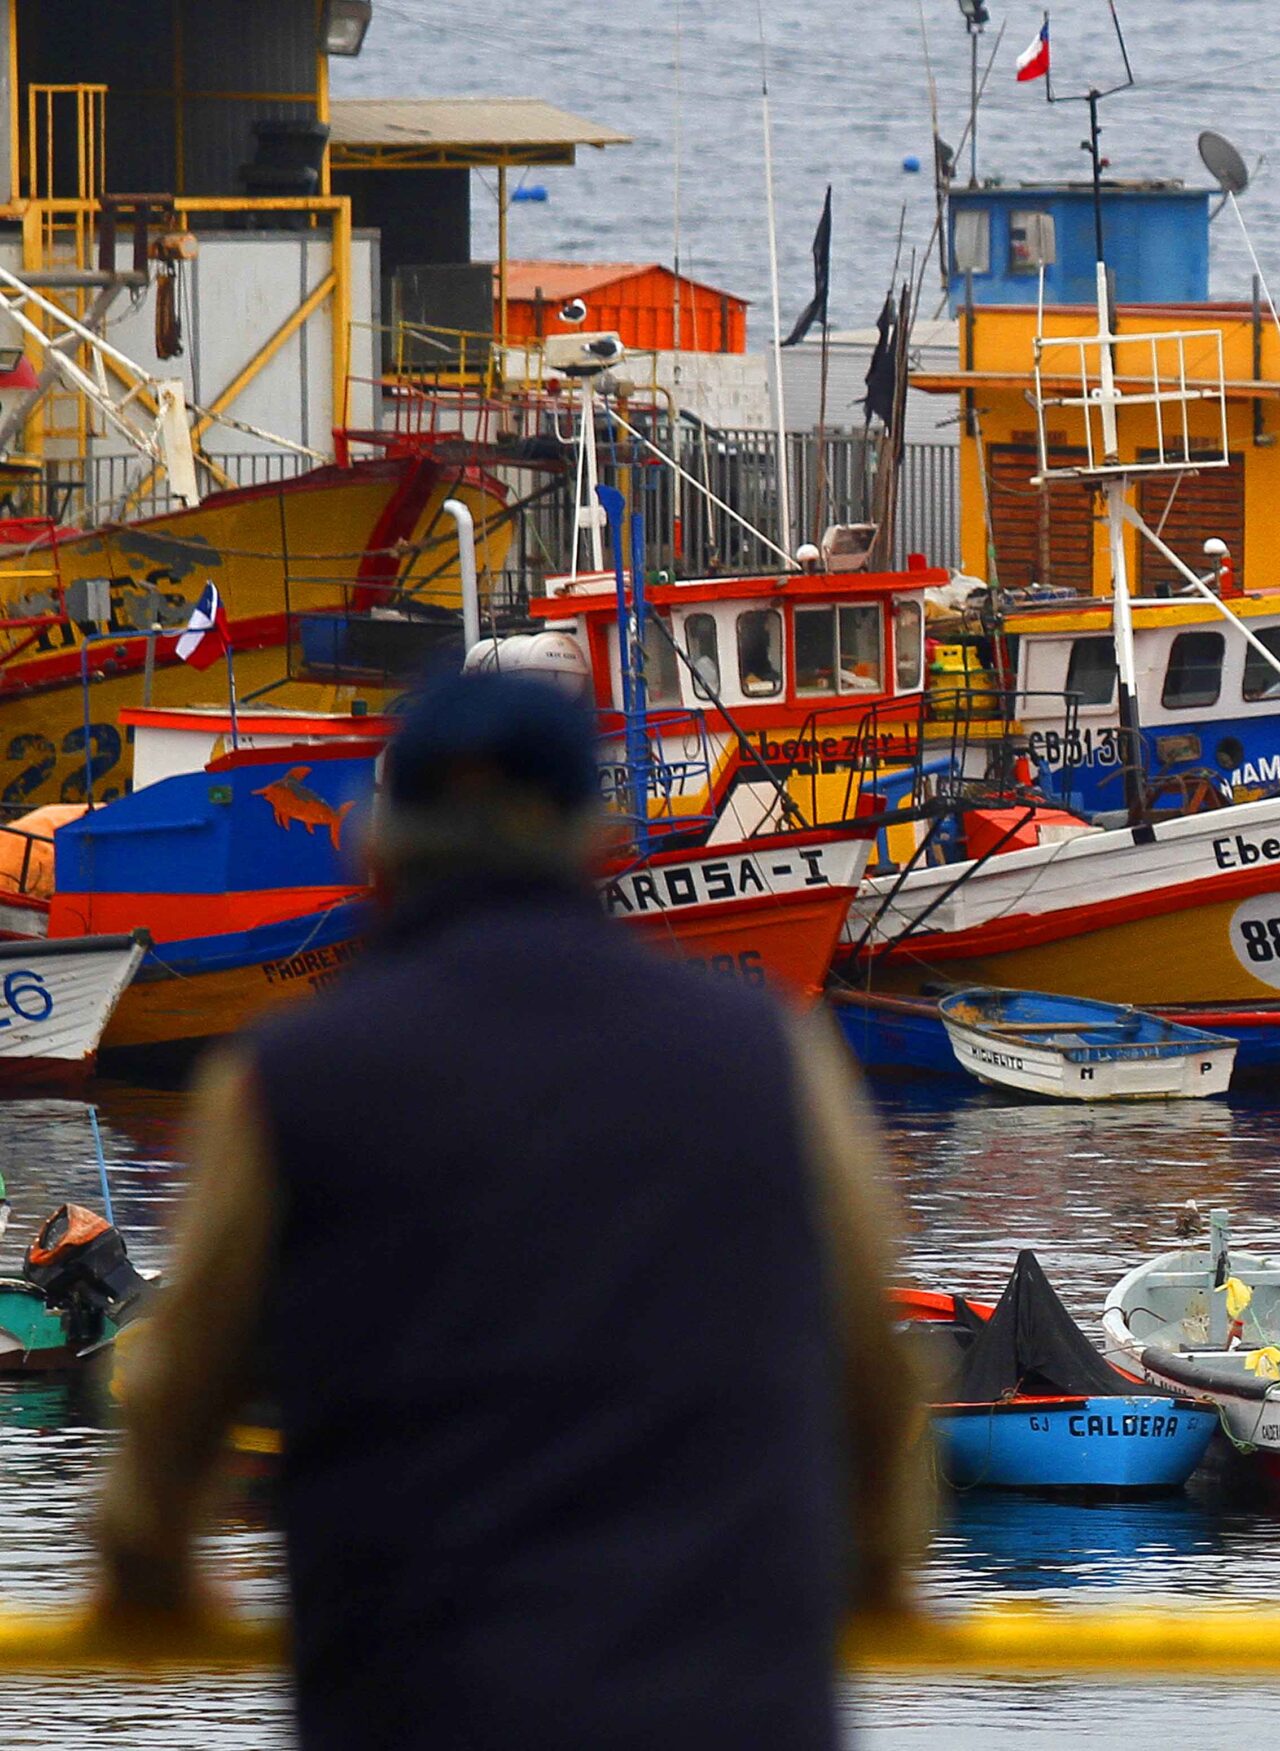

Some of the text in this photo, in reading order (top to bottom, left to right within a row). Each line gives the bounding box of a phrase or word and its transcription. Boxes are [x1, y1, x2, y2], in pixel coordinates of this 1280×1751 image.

[1080, 1062, 1213, 1080] M P
[1068, 1415, 1179, 1438] CALDERA
